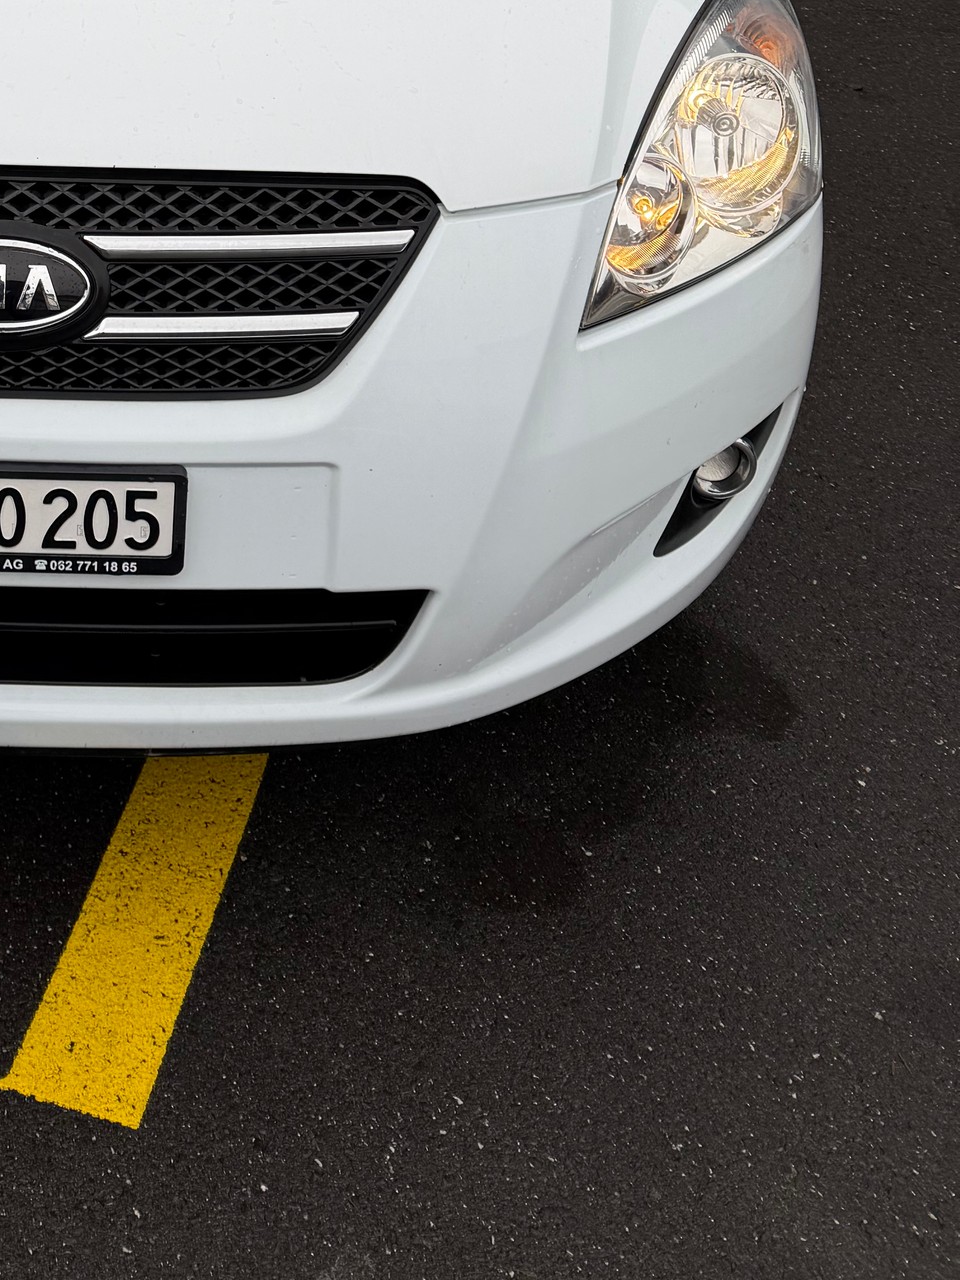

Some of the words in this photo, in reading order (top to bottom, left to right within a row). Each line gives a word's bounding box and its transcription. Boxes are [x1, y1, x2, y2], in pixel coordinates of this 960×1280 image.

[3, 559, 24, 570] AG
[76, 560, 98, 572] 771
[103, 561, 118, 572] 18
[121, 562, 138, 573] 65
